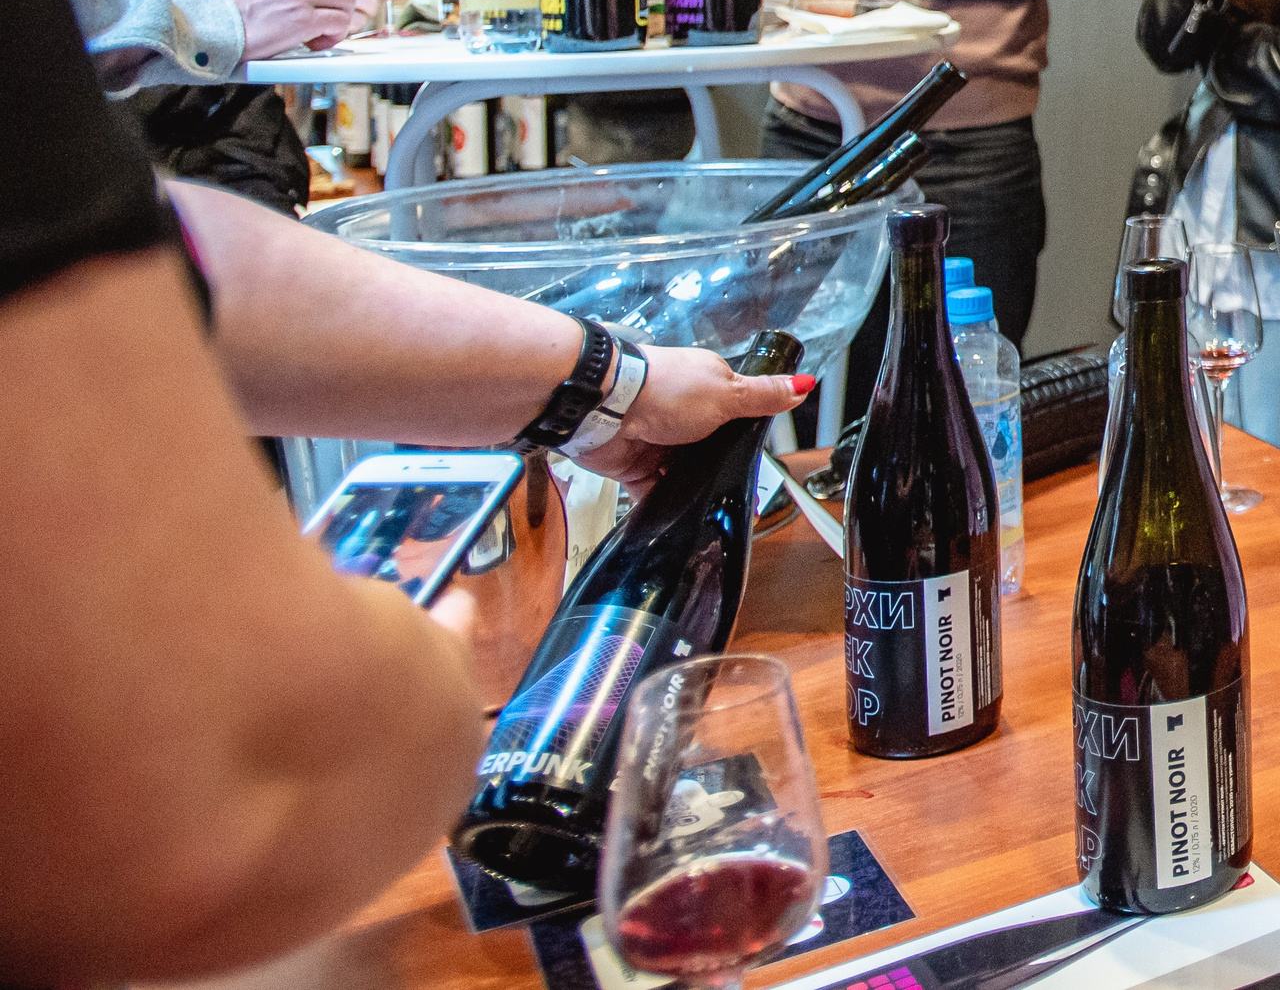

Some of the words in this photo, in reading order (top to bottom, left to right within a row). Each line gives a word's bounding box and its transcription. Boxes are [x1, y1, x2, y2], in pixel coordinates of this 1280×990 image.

[938, 614, 953, 662] NOIR
[940, 667, 955, 723] PINOT
[1073, 703, 1140, 762] ХИ
[477, 751, 594, 785] ERPUNK
[1168, 747, 1187, 805] NOIR
[1190, 795, 1198, 817] 2020
[1170, 810, 1190, 878] PINOT
